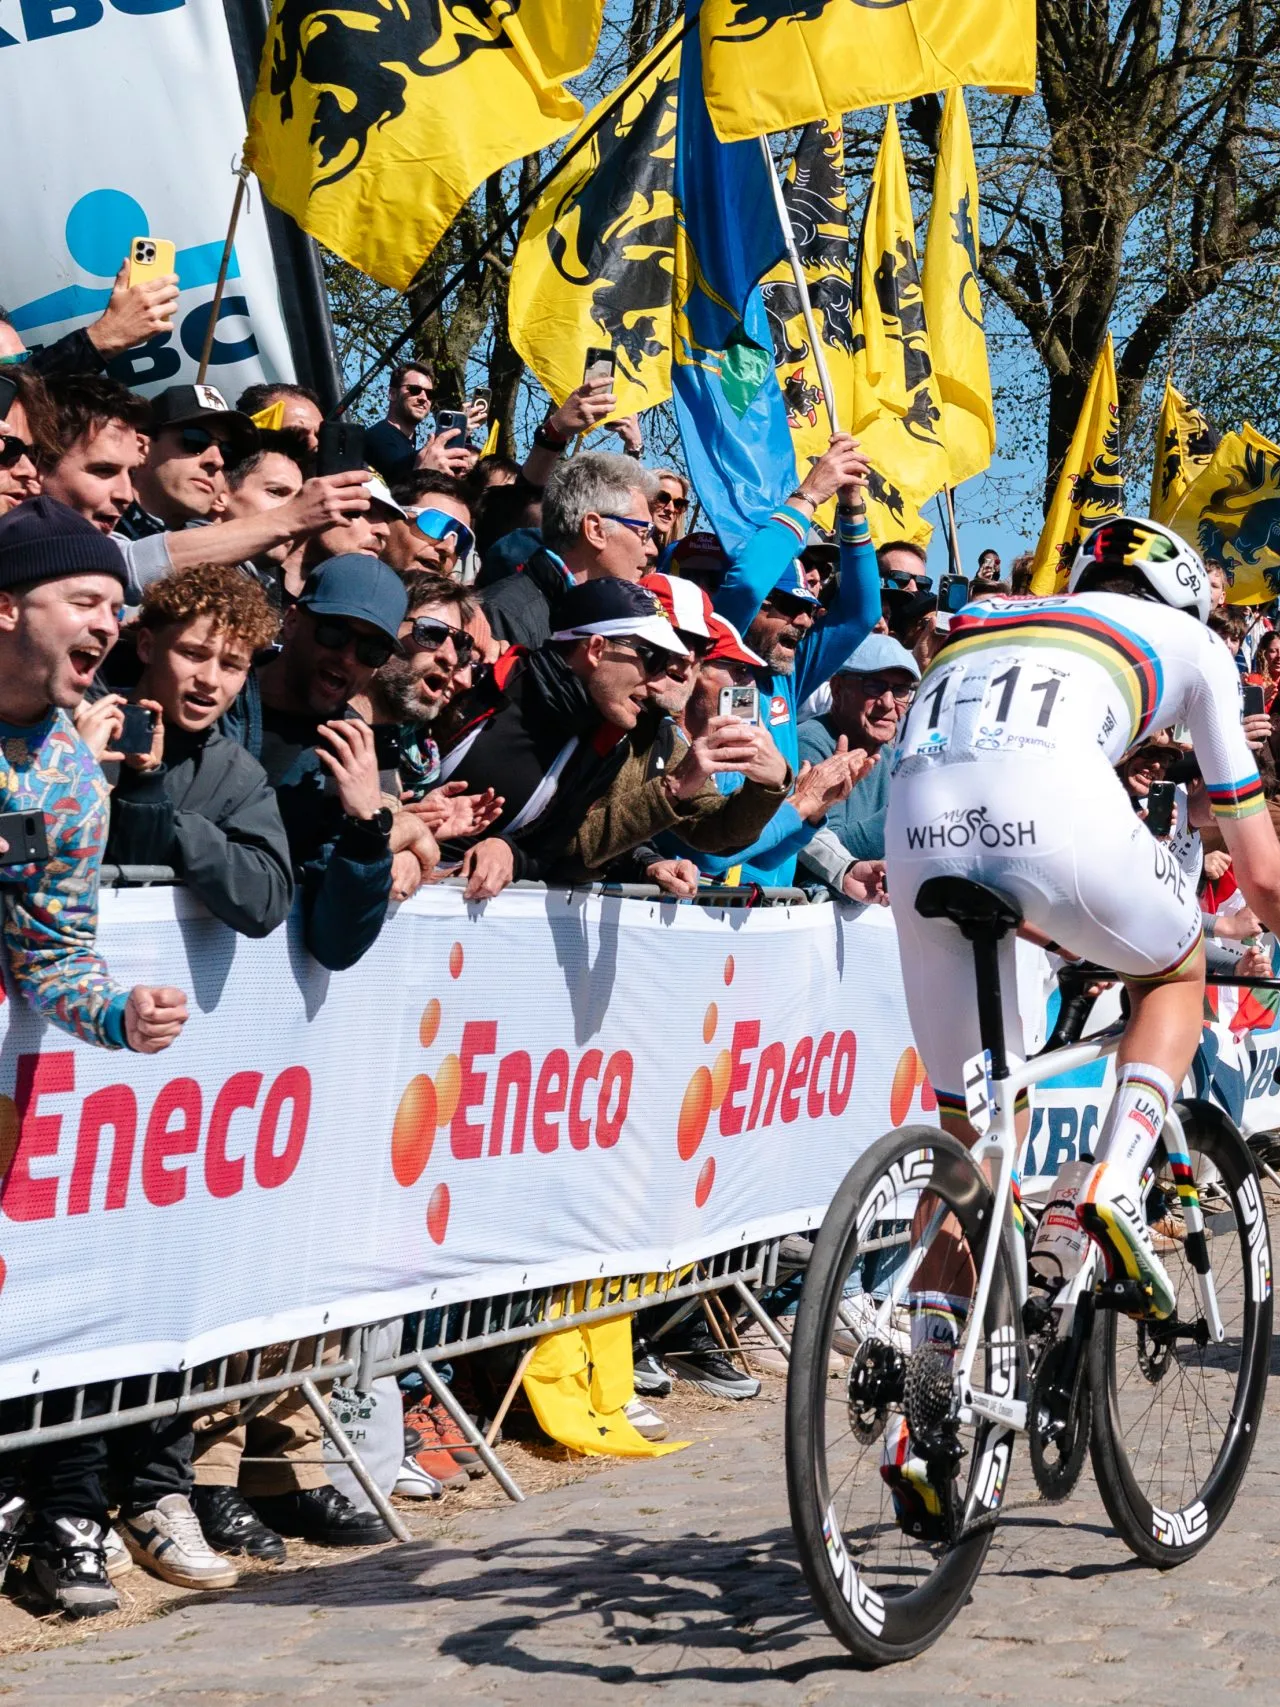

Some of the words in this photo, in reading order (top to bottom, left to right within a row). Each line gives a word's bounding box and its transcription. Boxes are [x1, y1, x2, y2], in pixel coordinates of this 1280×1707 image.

[103, 295, 260, 388] BC
[988, 666, 1061, 728] 11
[916, 742, 947, 755] KBC
[1008, 734, 1056, 749] proximus
[906, 820, 1037, 850] WHOOSH
[1154, 844, 1189, 906] UAE
[451, 1020, 634, 1160] Eneco
[719, 1020, 857, 1136] Eneco
[965, 1062, 989, 1119] 11
[0, 1051, 312, 1222] Eneco
[1135, 1097, 1162, 1132] UAE
